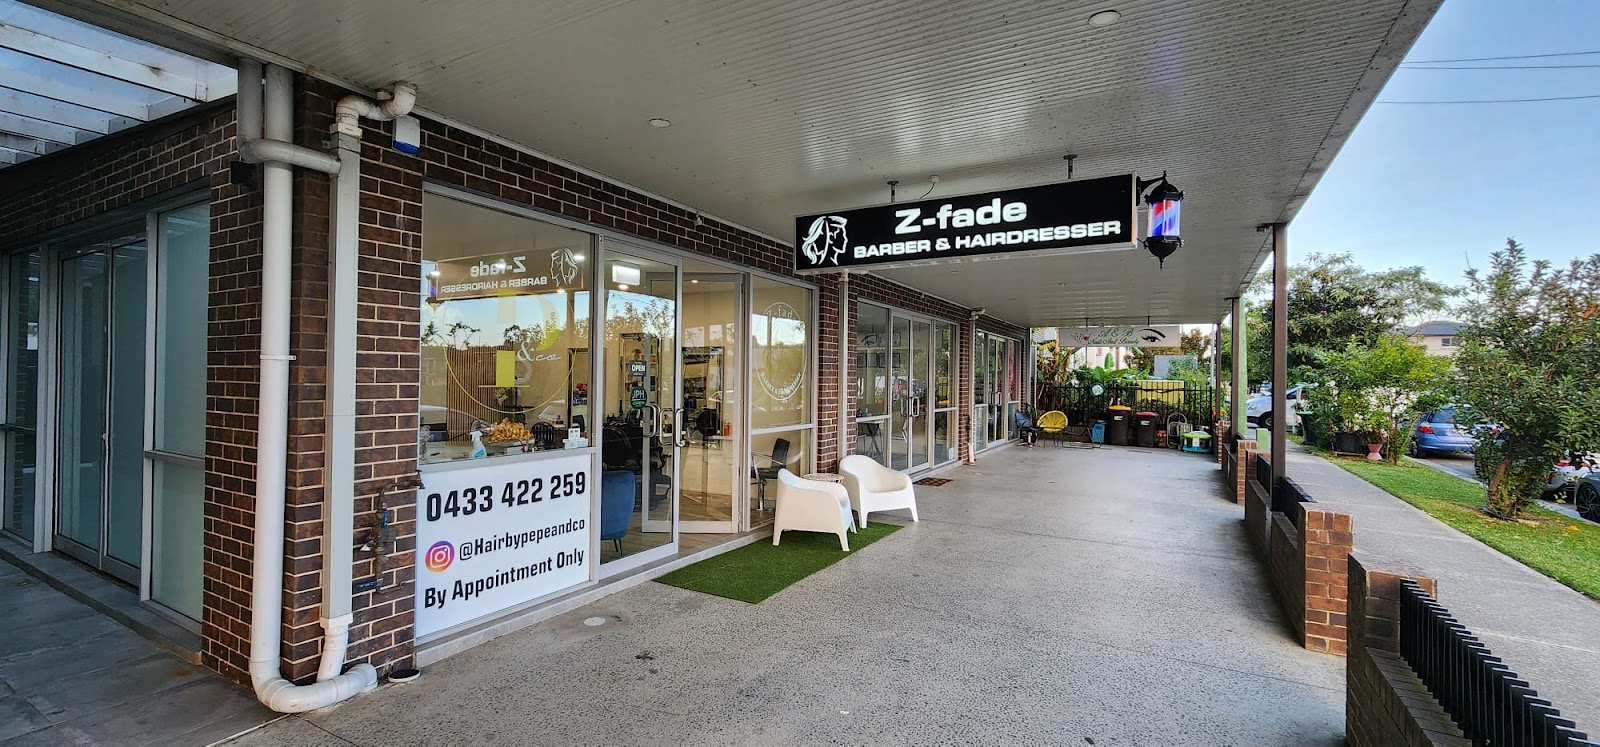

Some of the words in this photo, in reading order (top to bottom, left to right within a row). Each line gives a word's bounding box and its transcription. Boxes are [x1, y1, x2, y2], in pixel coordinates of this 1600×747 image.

[895, 196, 1027, 235] Z-fade
[853, 239, 931, 259] BARBER
[935, 238, 951, 251] &
[955, 220, 1121, 250] HAIRDRESSER
[631, 364, 646, 372] OPEN
[426, 485, 493, 522] 0433
[501, 477, 543, 508] 422
[550, 471, 586, 500] 259
[459, 517, 585, 561] @Hairbypepeandco
[424, 587, 447, 609] By
[451, 557, 553, 601] Appointment
[556, 548, 584, 570] Only
